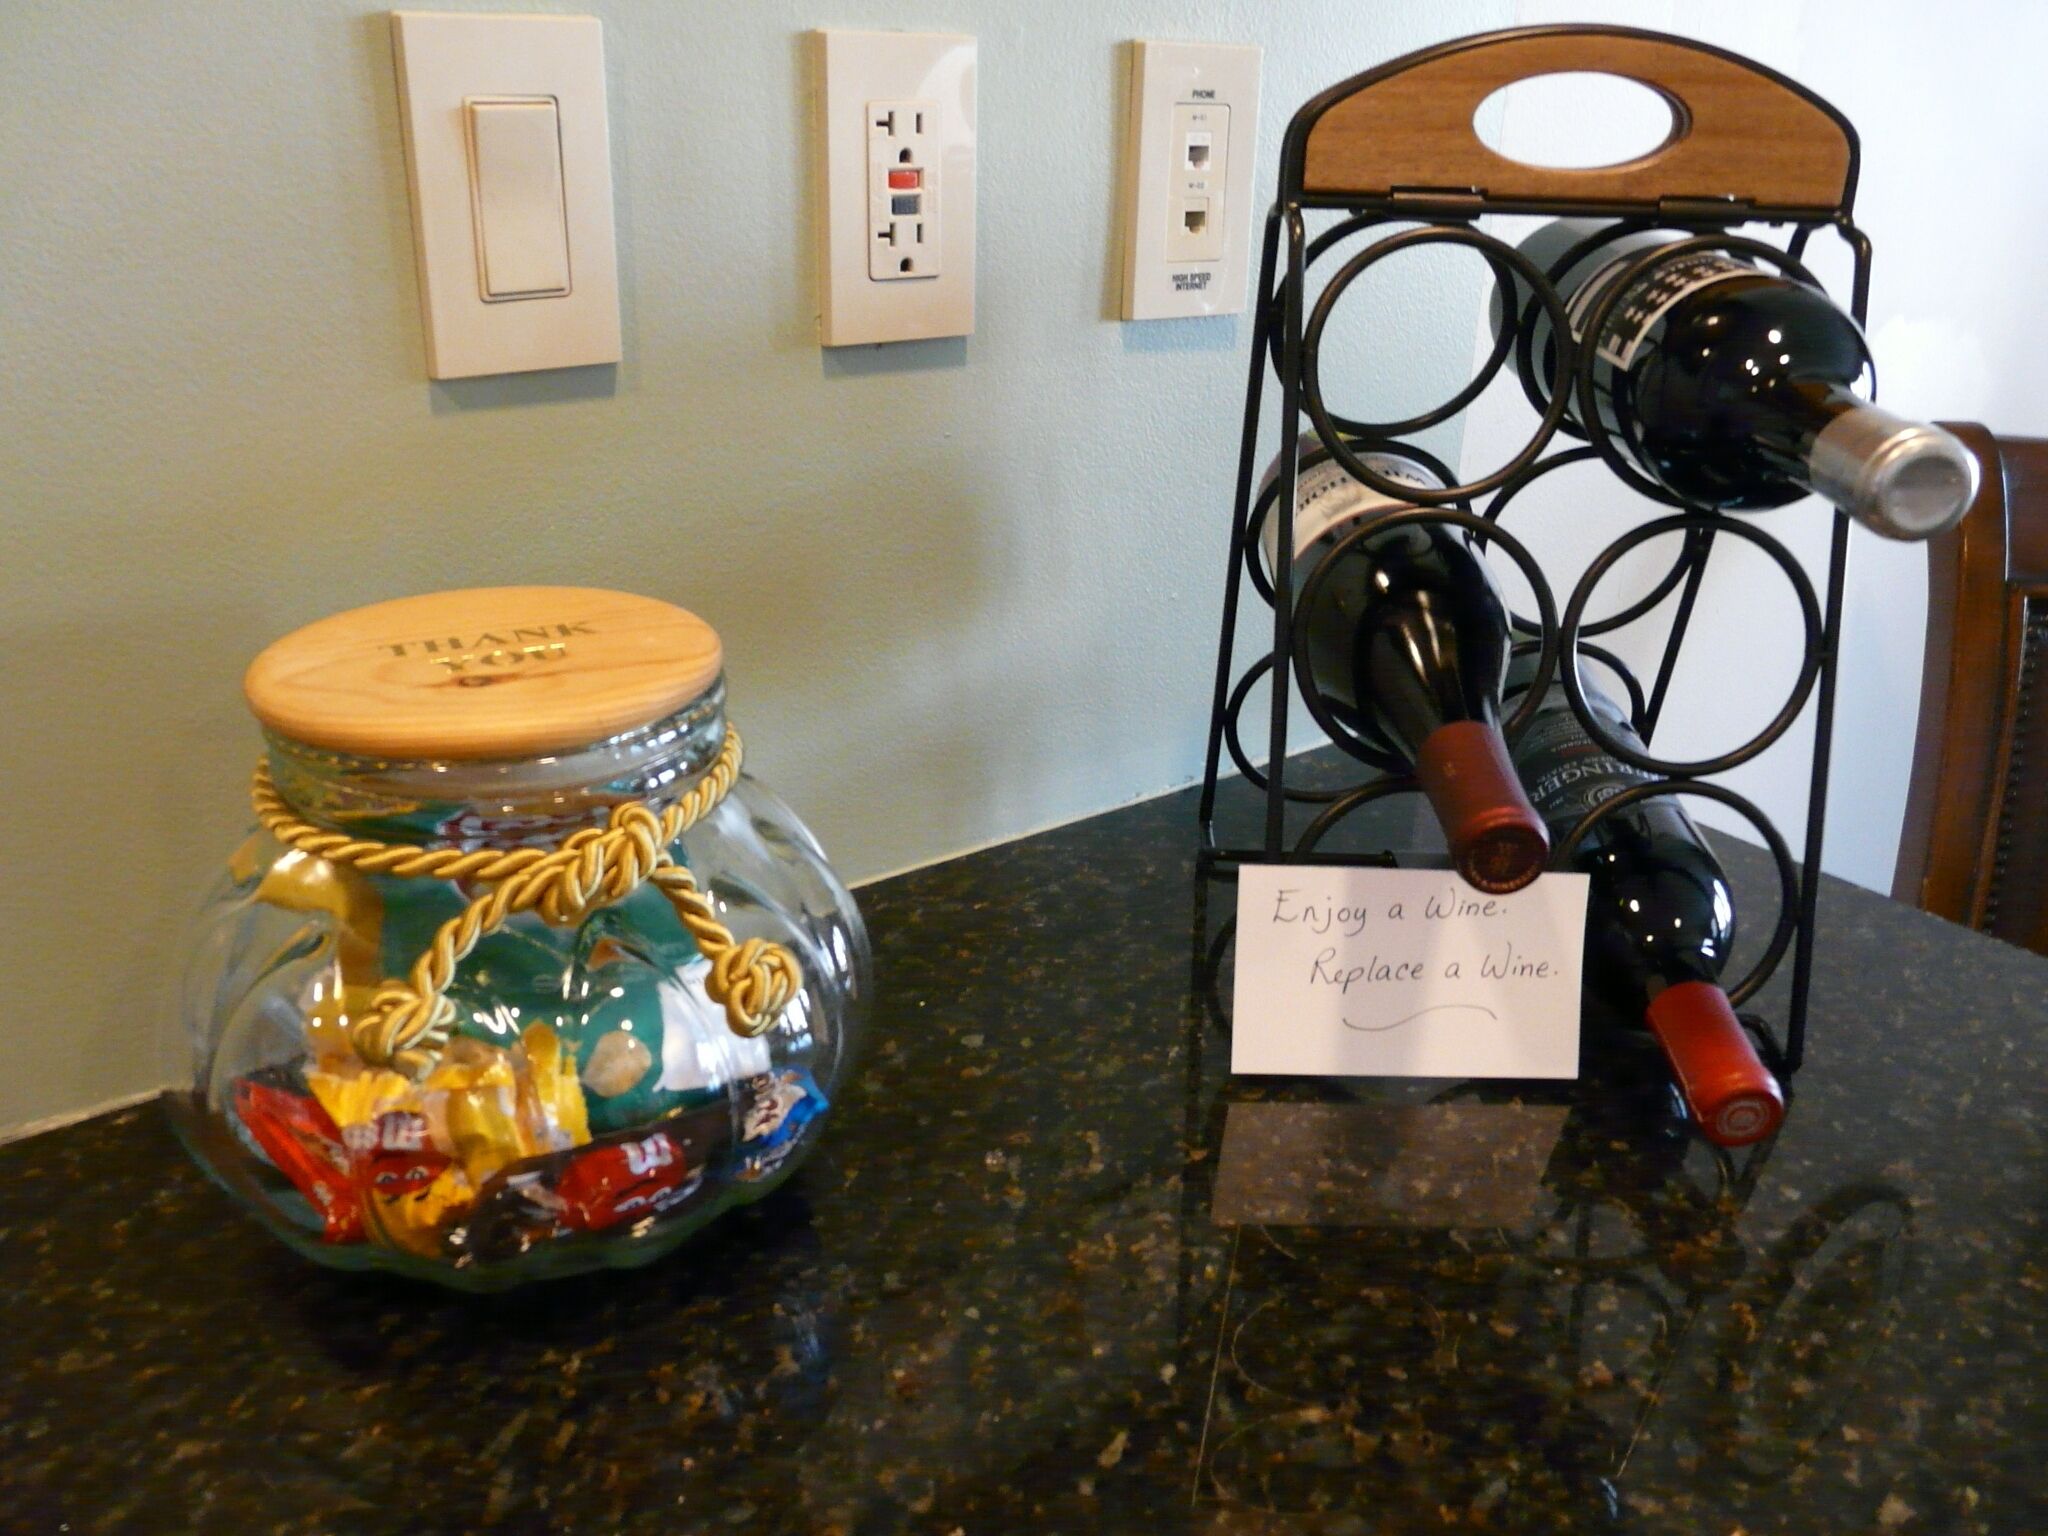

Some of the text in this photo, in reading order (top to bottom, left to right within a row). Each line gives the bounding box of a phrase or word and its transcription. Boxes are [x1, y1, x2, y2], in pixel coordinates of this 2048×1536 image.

[1191, 89, 1216, 99] PHONE
[1172, 272, 1212, 282] HIGH SPEED
[1175, 282, 1207, 292] INTERNET
[377, 621, 598, 657] THANK
[430, 641, 567, 671] YOU
[1272, 887, 1508, 937] Enjoy a Wine.
[1310, 941, 1559, 995] Replace a Wine.
